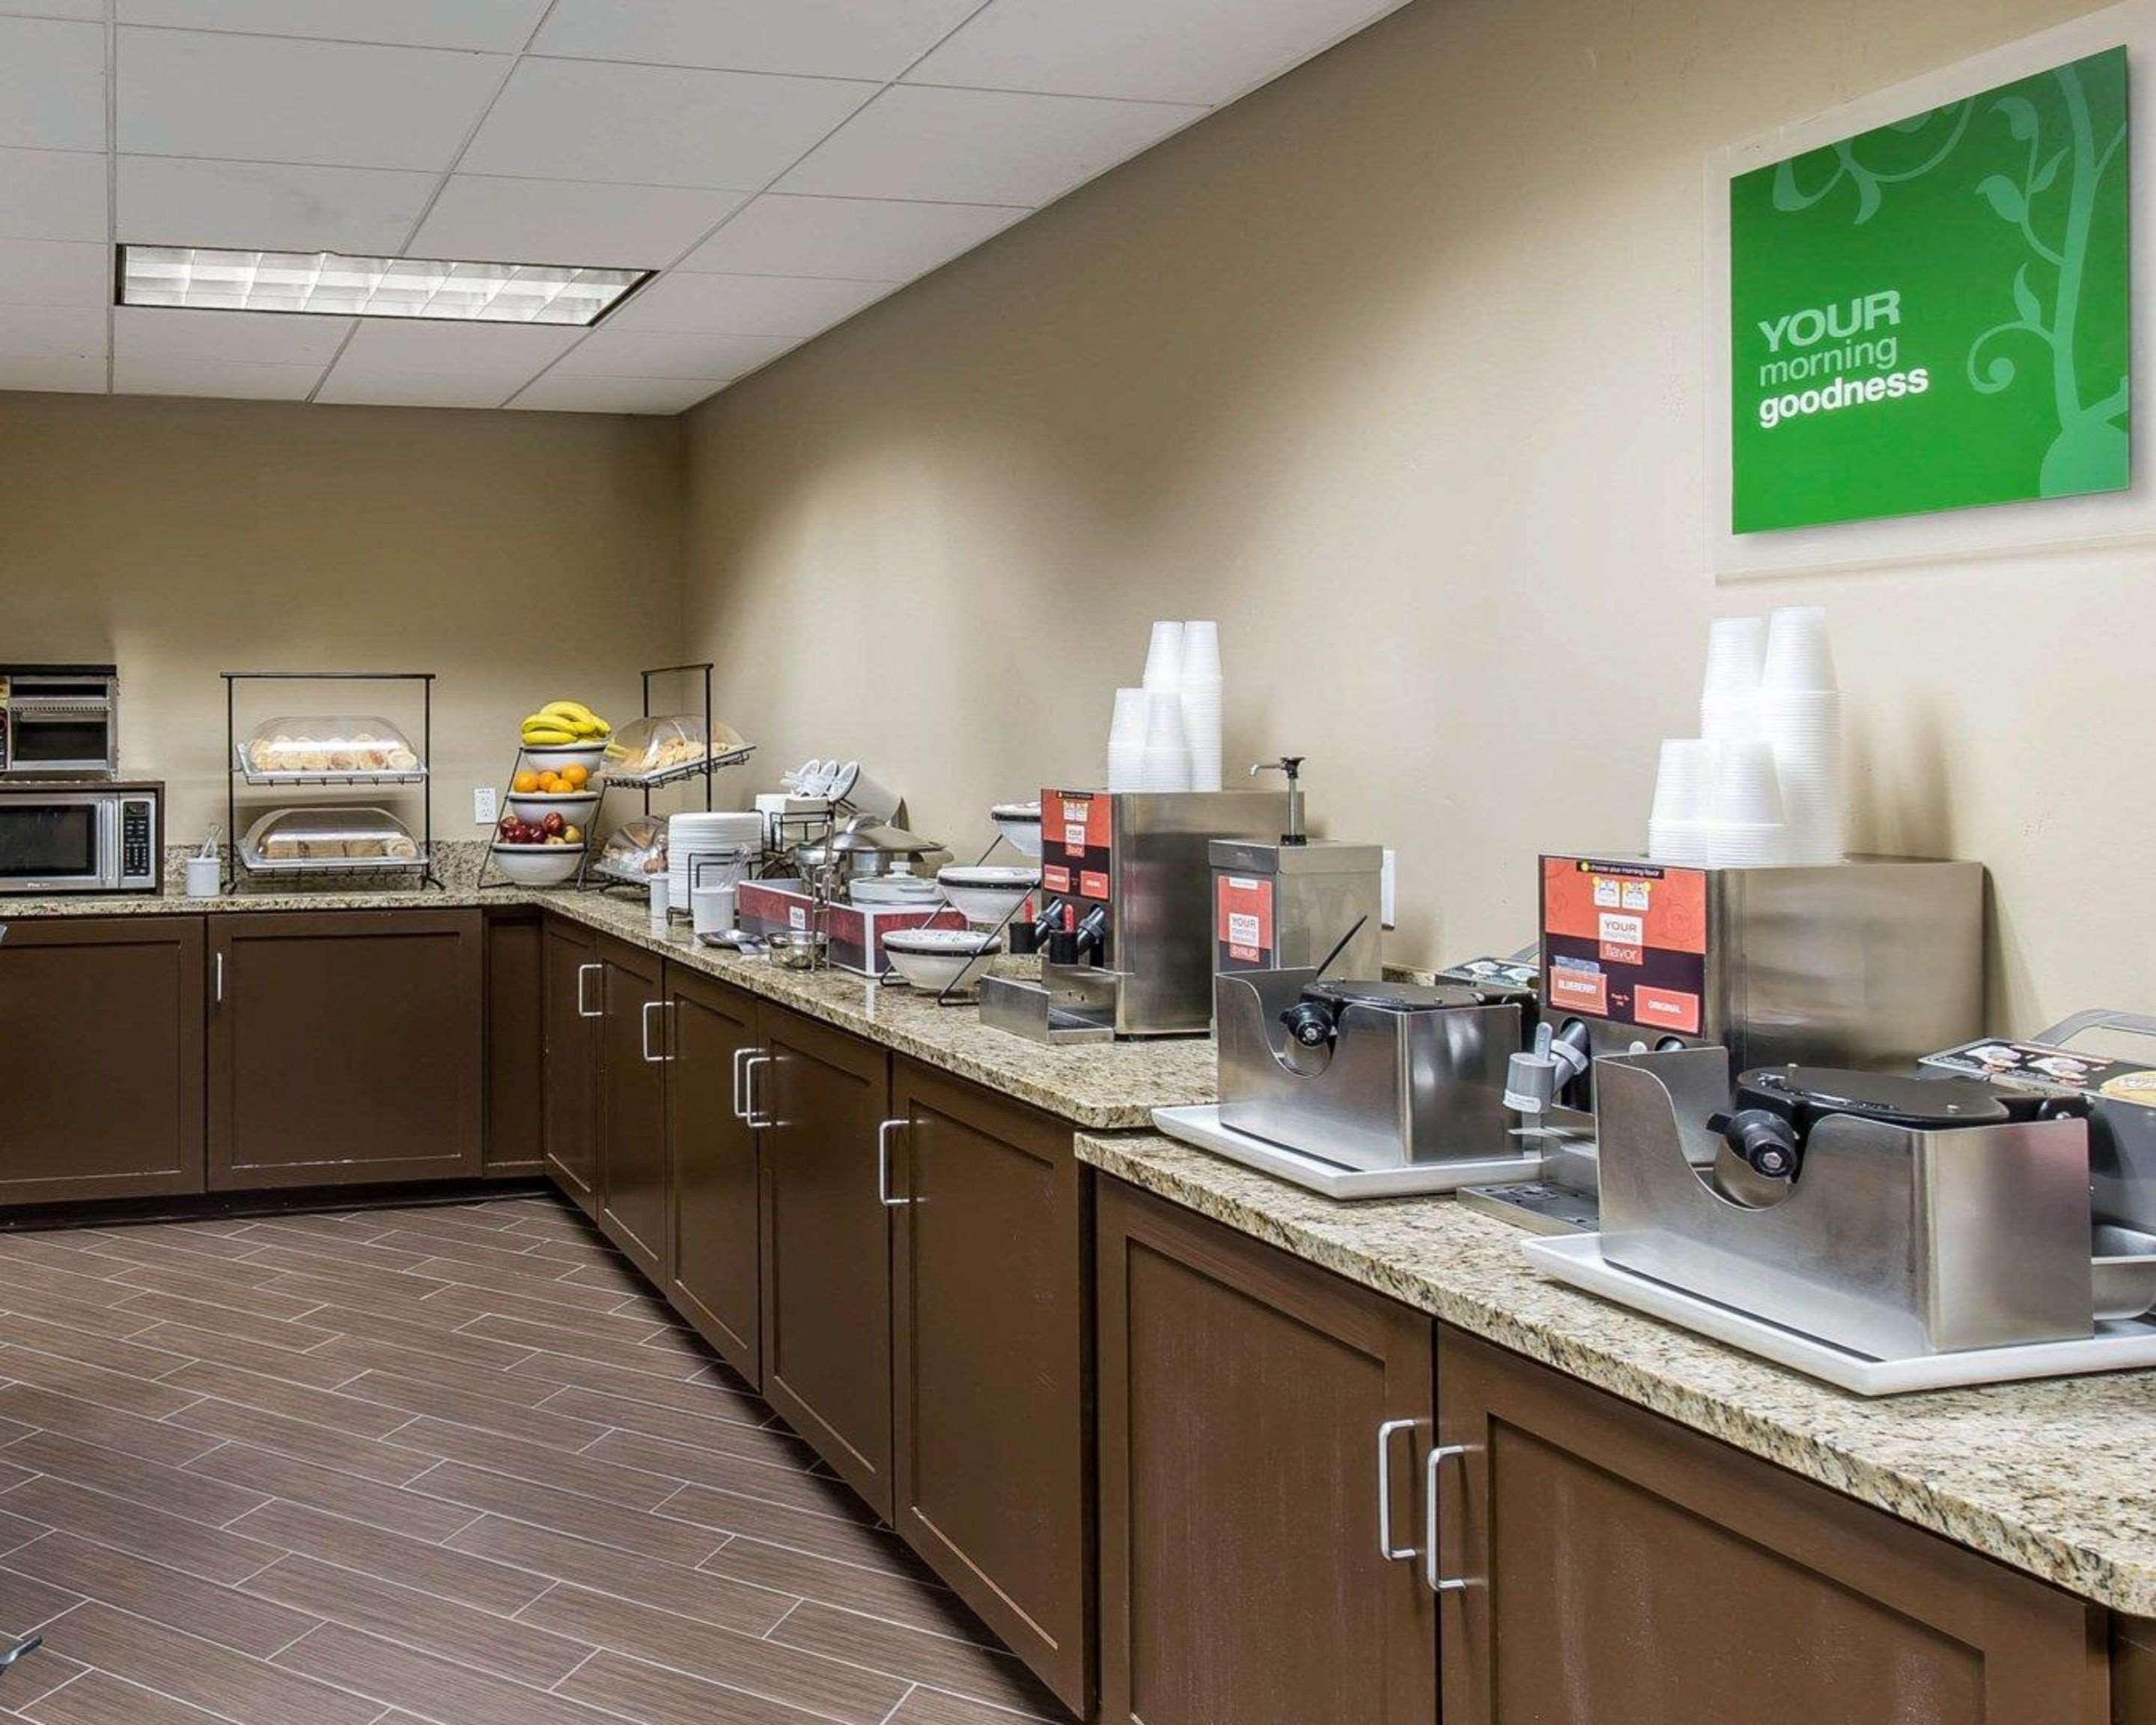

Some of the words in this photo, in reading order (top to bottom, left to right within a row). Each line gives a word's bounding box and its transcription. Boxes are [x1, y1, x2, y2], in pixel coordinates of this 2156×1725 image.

[1758, 290, 1901, 353] YOUR
[1759, 336, 1898, 387] morning
[1758, 368, 1929, 429] goodness
[1621, 867, 1644, 877] morning
[1231, 916, 1257, 930] YOUR
[1604, 920, 1637, 933] YOUR
[1604, 931, 1637, 943] morning
[1231, 944, 1258, 959] SYRUP
[1604, 943, 1639, 961] flavor
[1557, 979, 1598, 994] BLUEBERRY
[1647, 999, 1682, 1014] ORIGINAL
